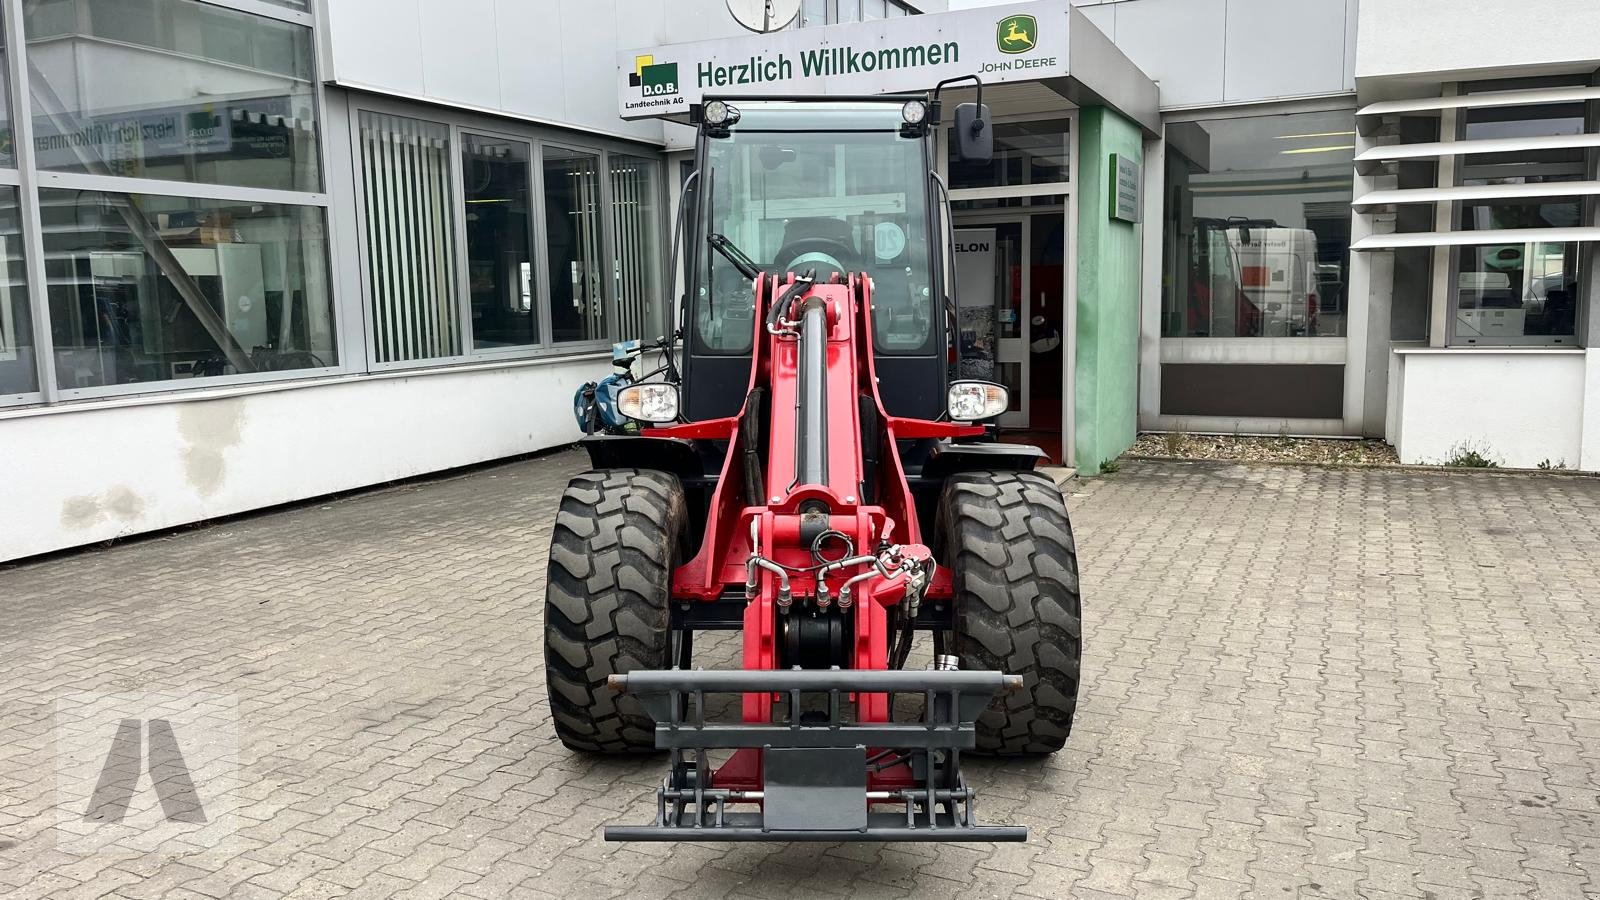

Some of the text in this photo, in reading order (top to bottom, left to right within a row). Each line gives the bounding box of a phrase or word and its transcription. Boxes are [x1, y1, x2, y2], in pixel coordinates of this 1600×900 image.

[697, 40, 960, 89] Herzlich Willkommen
[978, 57, 1057, 74] JOHN DEERE
[643, 82, 678, 96] D.O.B.
[625, 97, 684, 109] Landtechnik AG
[949, 243, 990, 253] ELON
